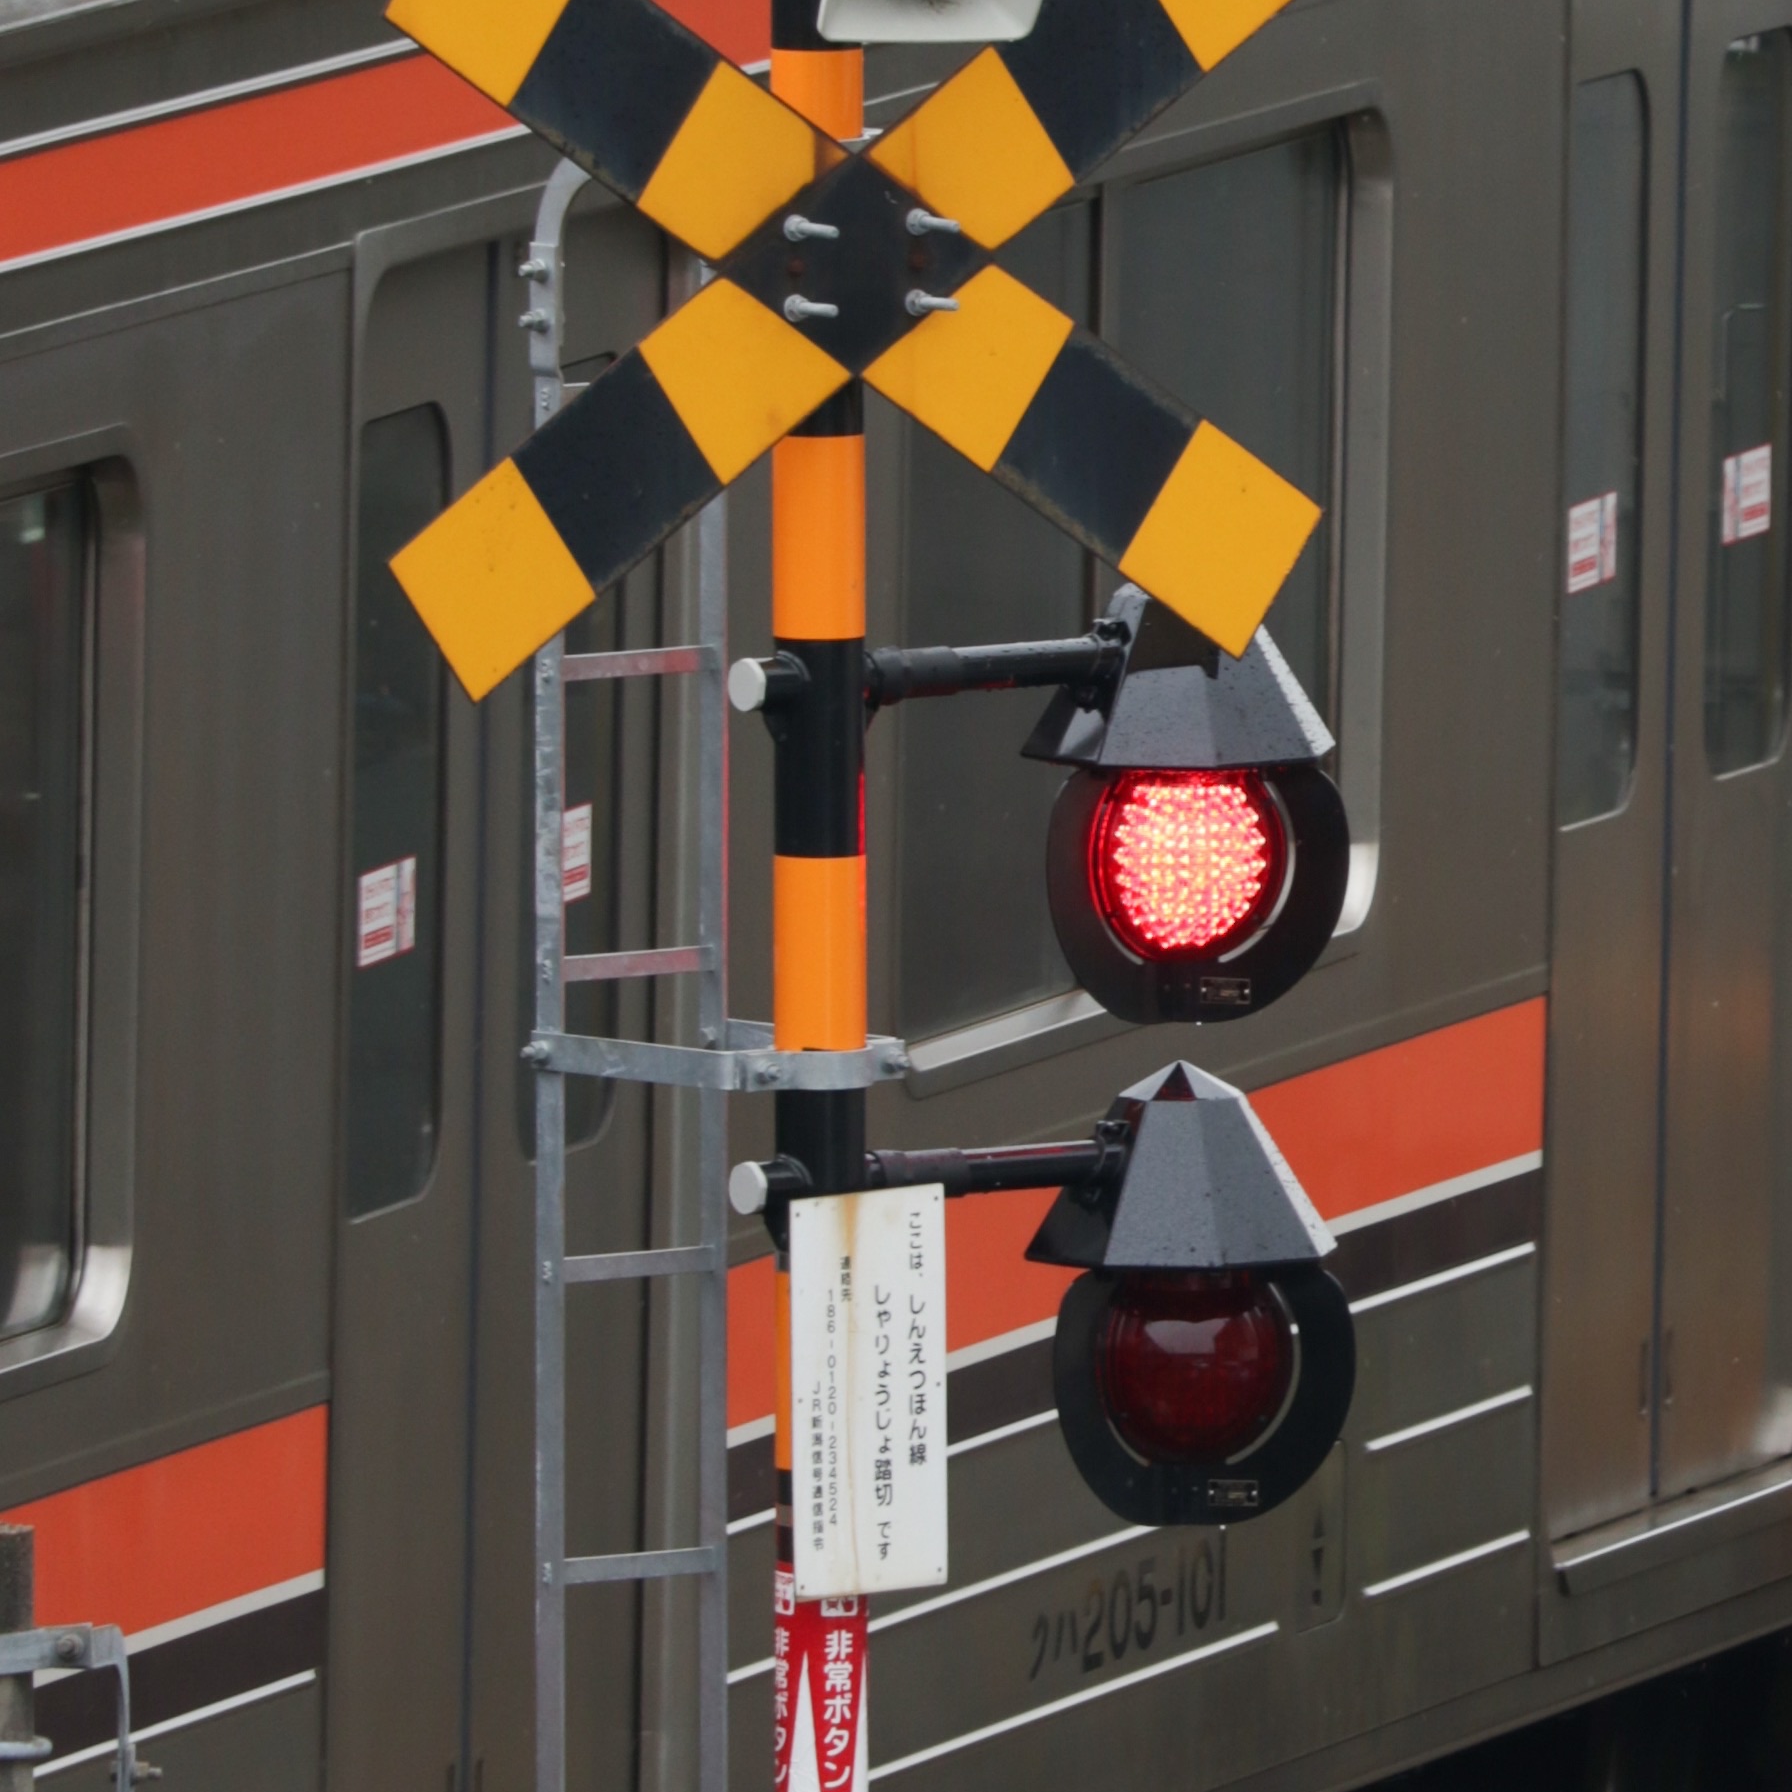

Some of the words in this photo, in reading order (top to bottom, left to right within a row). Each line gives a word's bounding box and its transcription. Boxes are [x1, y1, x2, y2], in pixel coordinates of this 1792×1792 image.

[874, 1283, 893, 1508] しゃりょうじょ踏切
[908, 1293, 927, 1467] しんえつほん線
[876, 1520, 892, 1561] です
[823, 1628, 854, 1790] 非常ボタン
